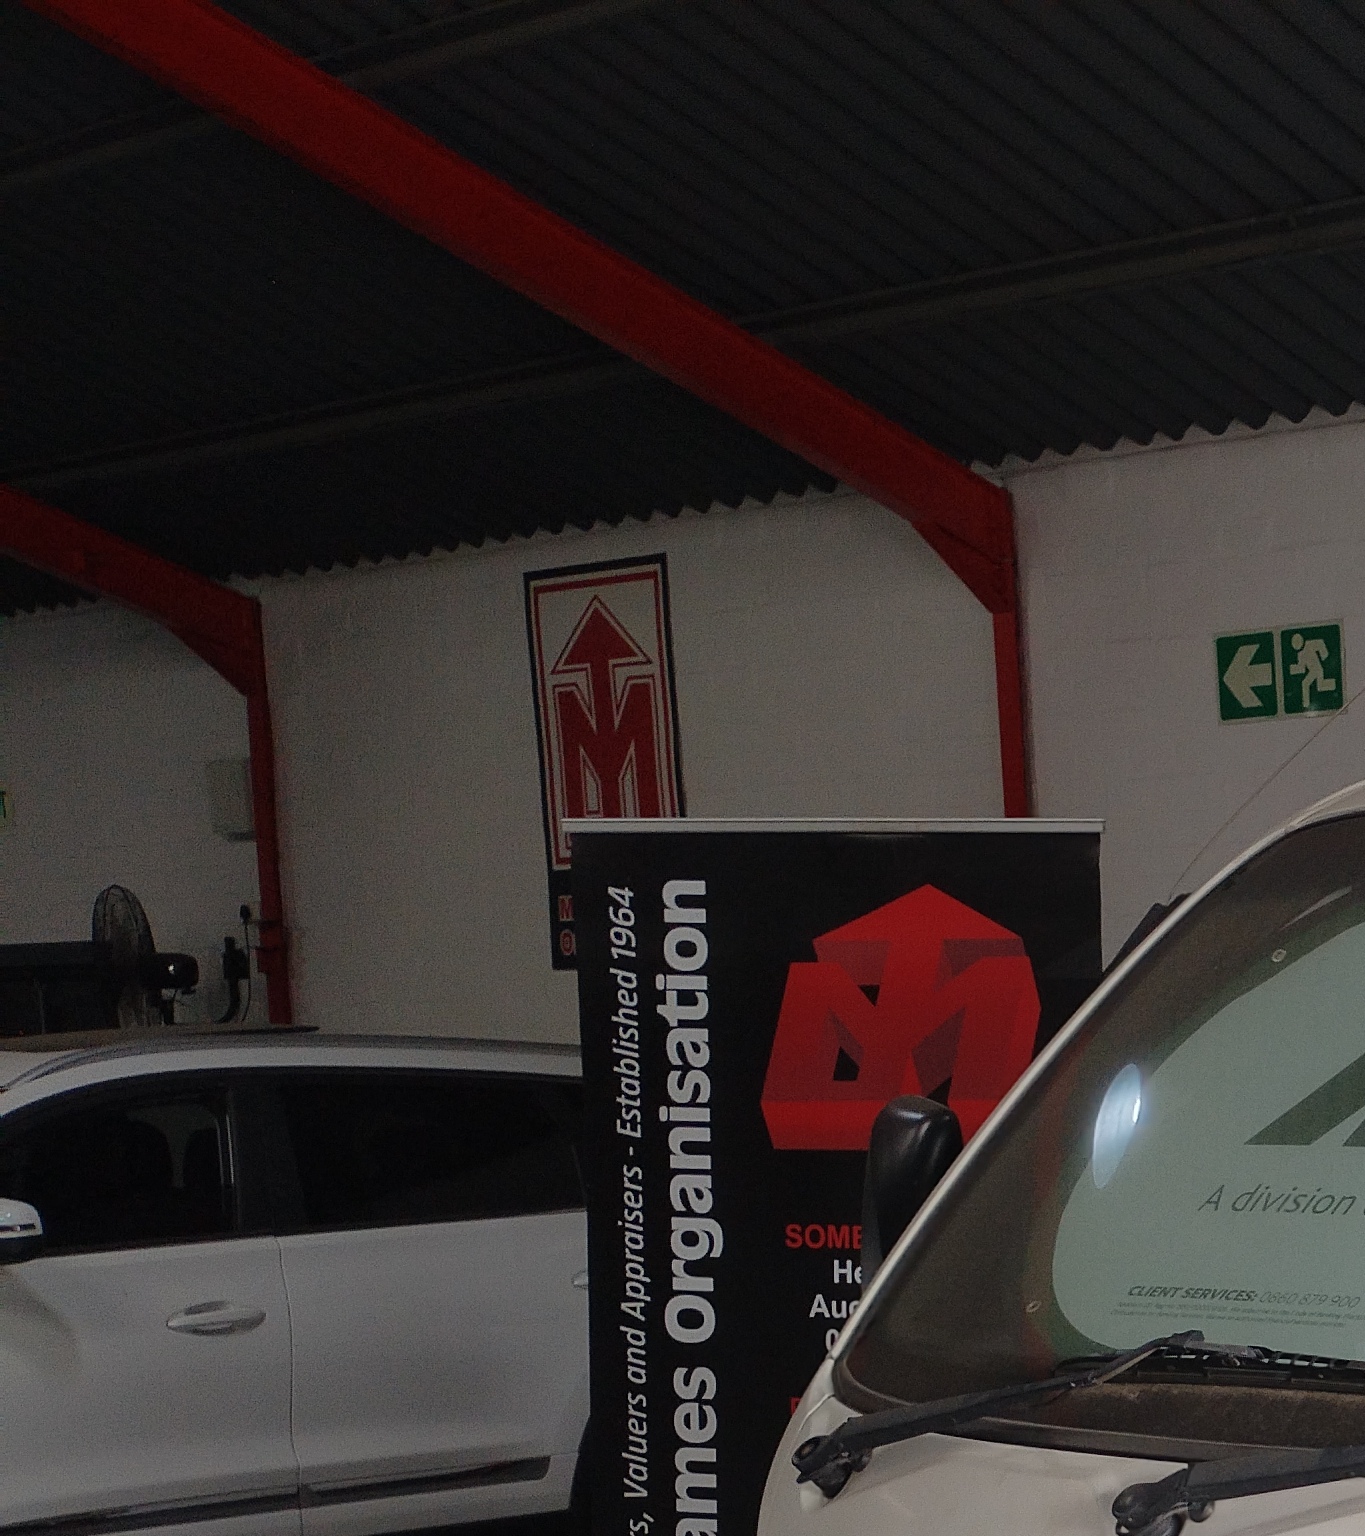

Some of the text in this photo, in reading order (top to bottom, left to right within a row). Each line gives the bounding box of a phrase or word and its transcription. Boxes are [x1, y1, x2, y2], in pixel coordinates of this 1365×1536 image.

[607, 886, 637, 959] 1964
[609, 967, 642, 1138] Established
[657, 879, 724, 1344] organisation
[617, 1164, 652, 1322] Appraisers
[1198, 1184, 1225, 1211] A
[1231, 1183, 1357, 1215] division
[1127, 1285, 1183, 1299] CLIENT
[1183, 1287, 1258, 1302] SERVICES:
[1329, 1295, 1361, 1308] 900
[619, 1324, 647, 1385] and
[622, 1391, 649, 1498] Valuers
